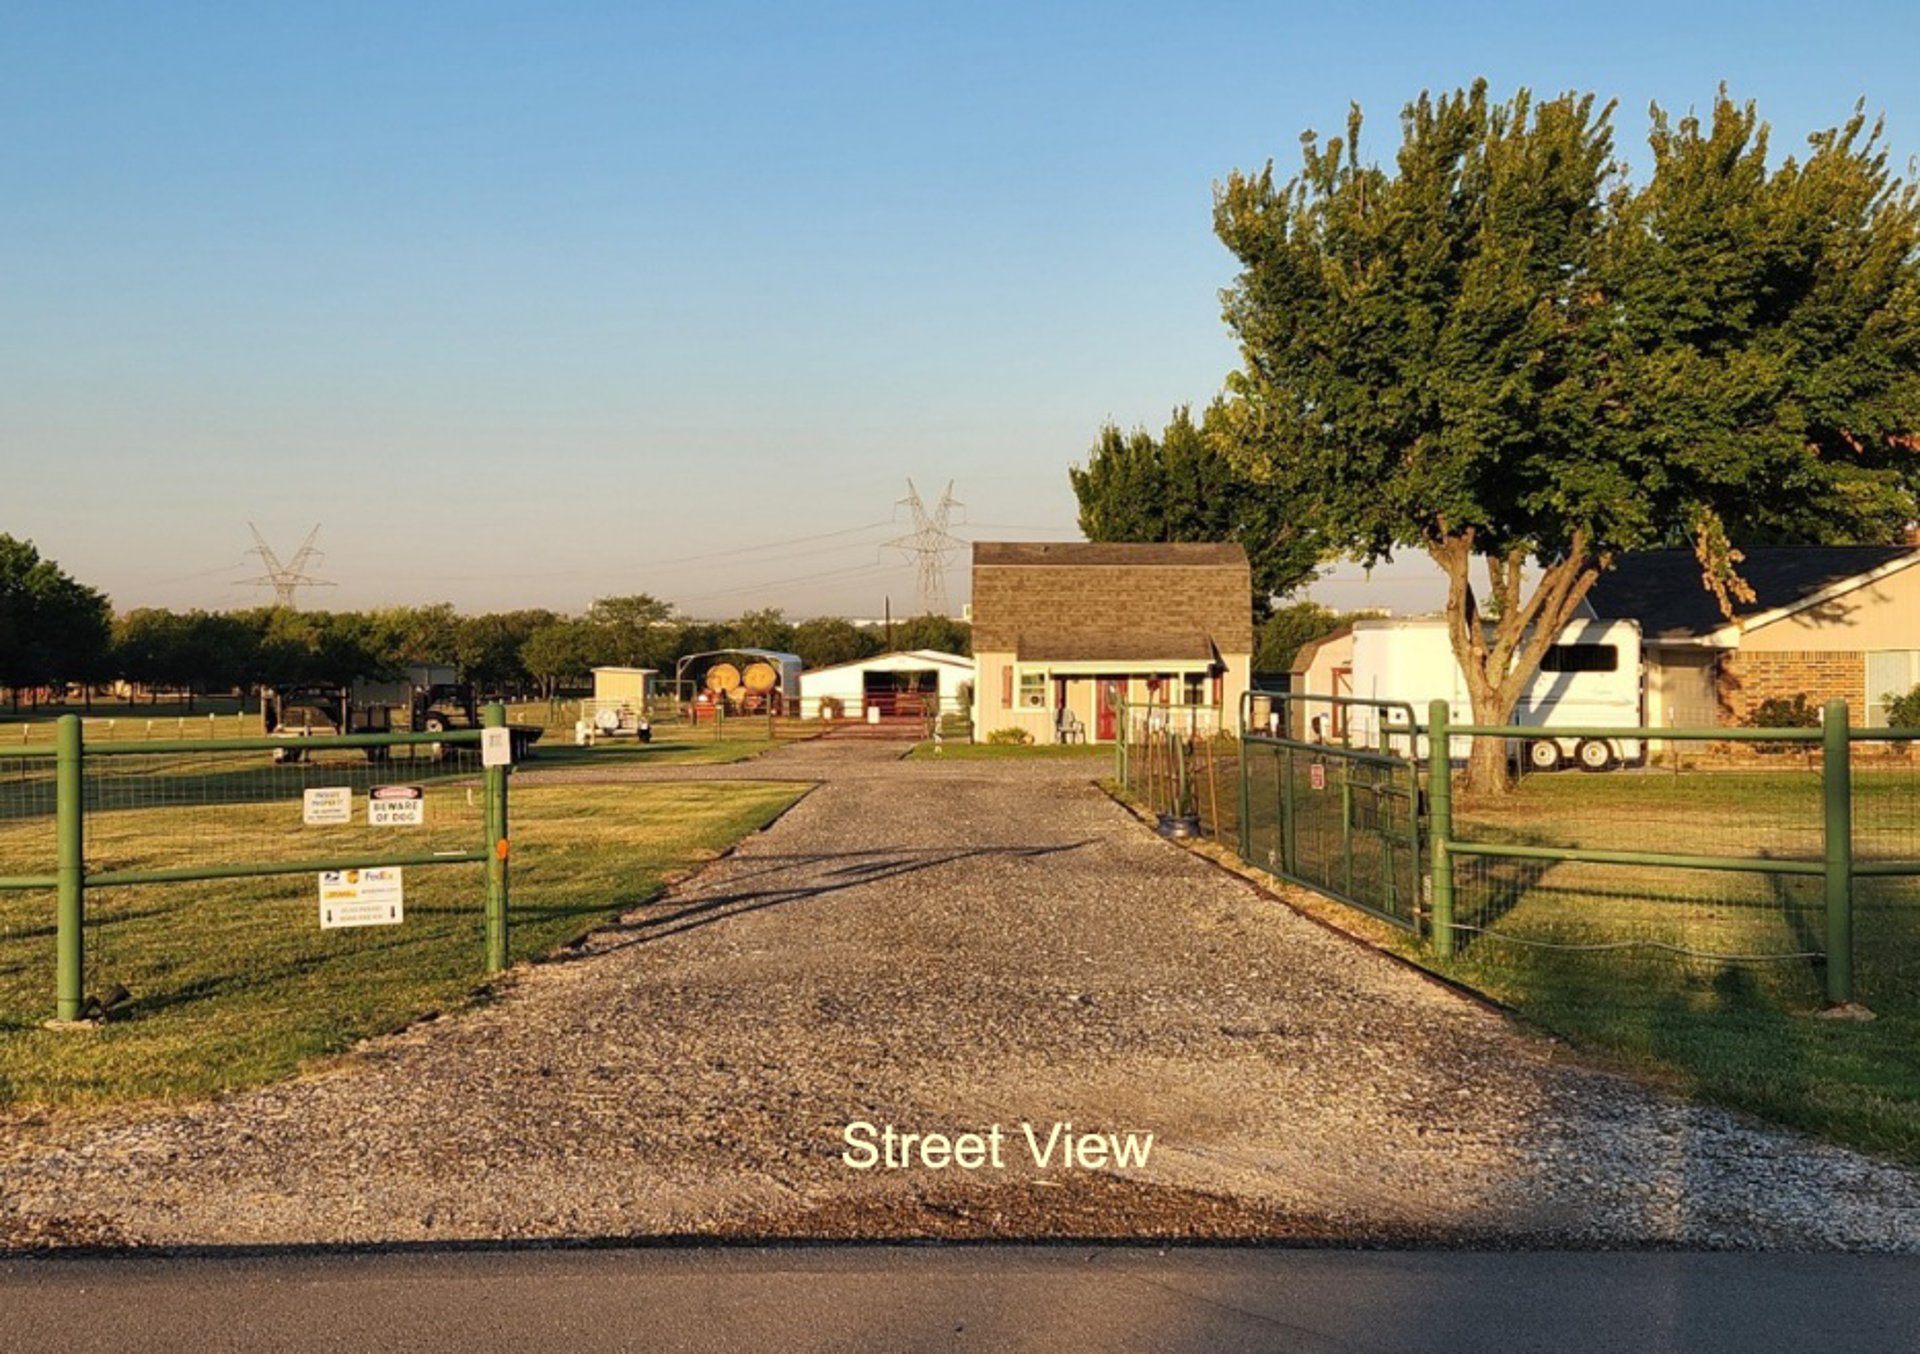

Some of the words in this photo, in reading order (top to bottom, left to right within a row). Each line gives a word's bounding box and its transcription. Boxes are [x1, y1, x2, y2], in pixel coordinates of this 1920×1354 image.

[373, 801, 418, 811] BEWARE
[375, 813, 388, 822] OF
[392, 812, 416, 822] DOG
